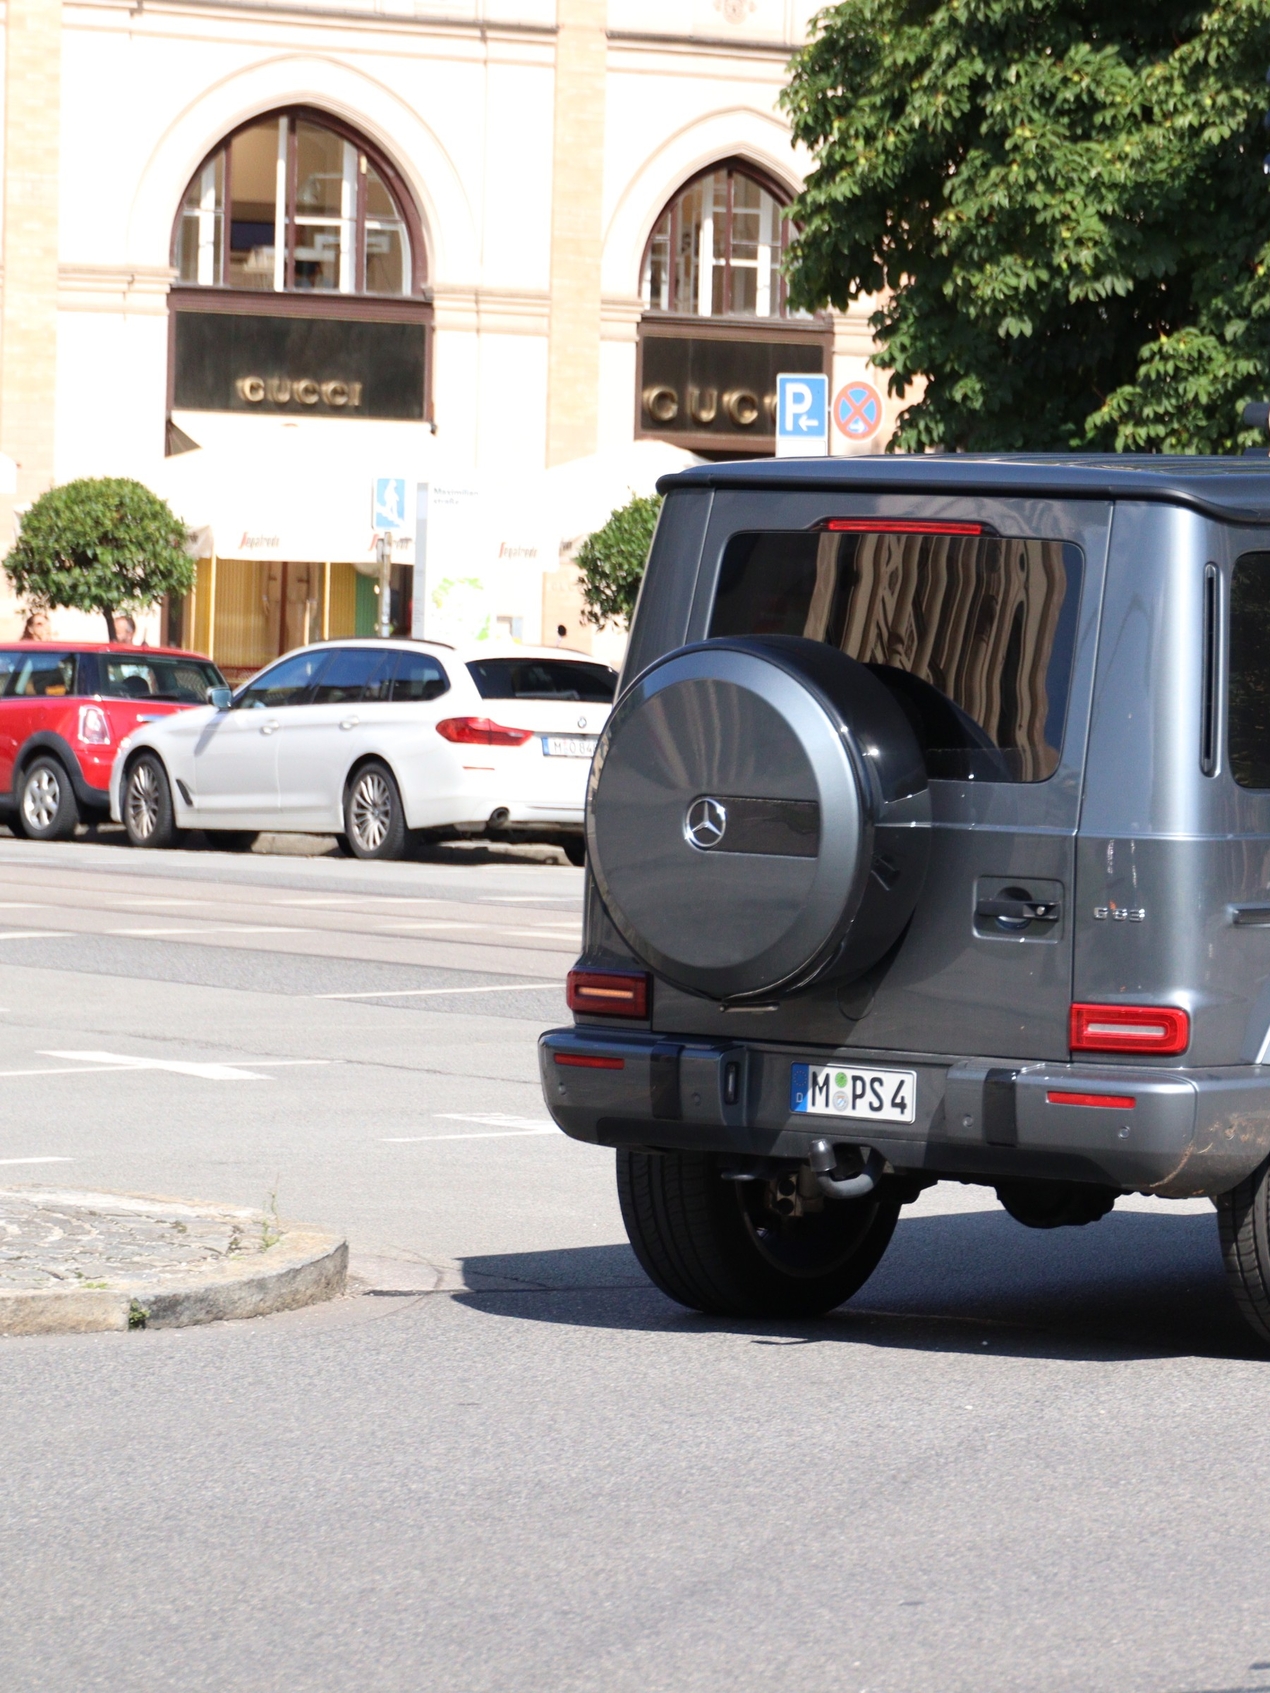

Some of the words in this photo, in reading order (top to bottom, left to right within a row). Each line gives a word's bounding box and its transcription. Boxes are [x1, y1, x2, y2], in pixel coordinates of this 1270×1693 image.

[237, 376, 362, 406] GUCCI
[643, 384, 777, 425] GUC
[785, 382, 813, 431] P
[812, 1071, 830, 1108] M
[851, 1075, 884, 1112] PS
[891, 1079, 907, 1115] 4
